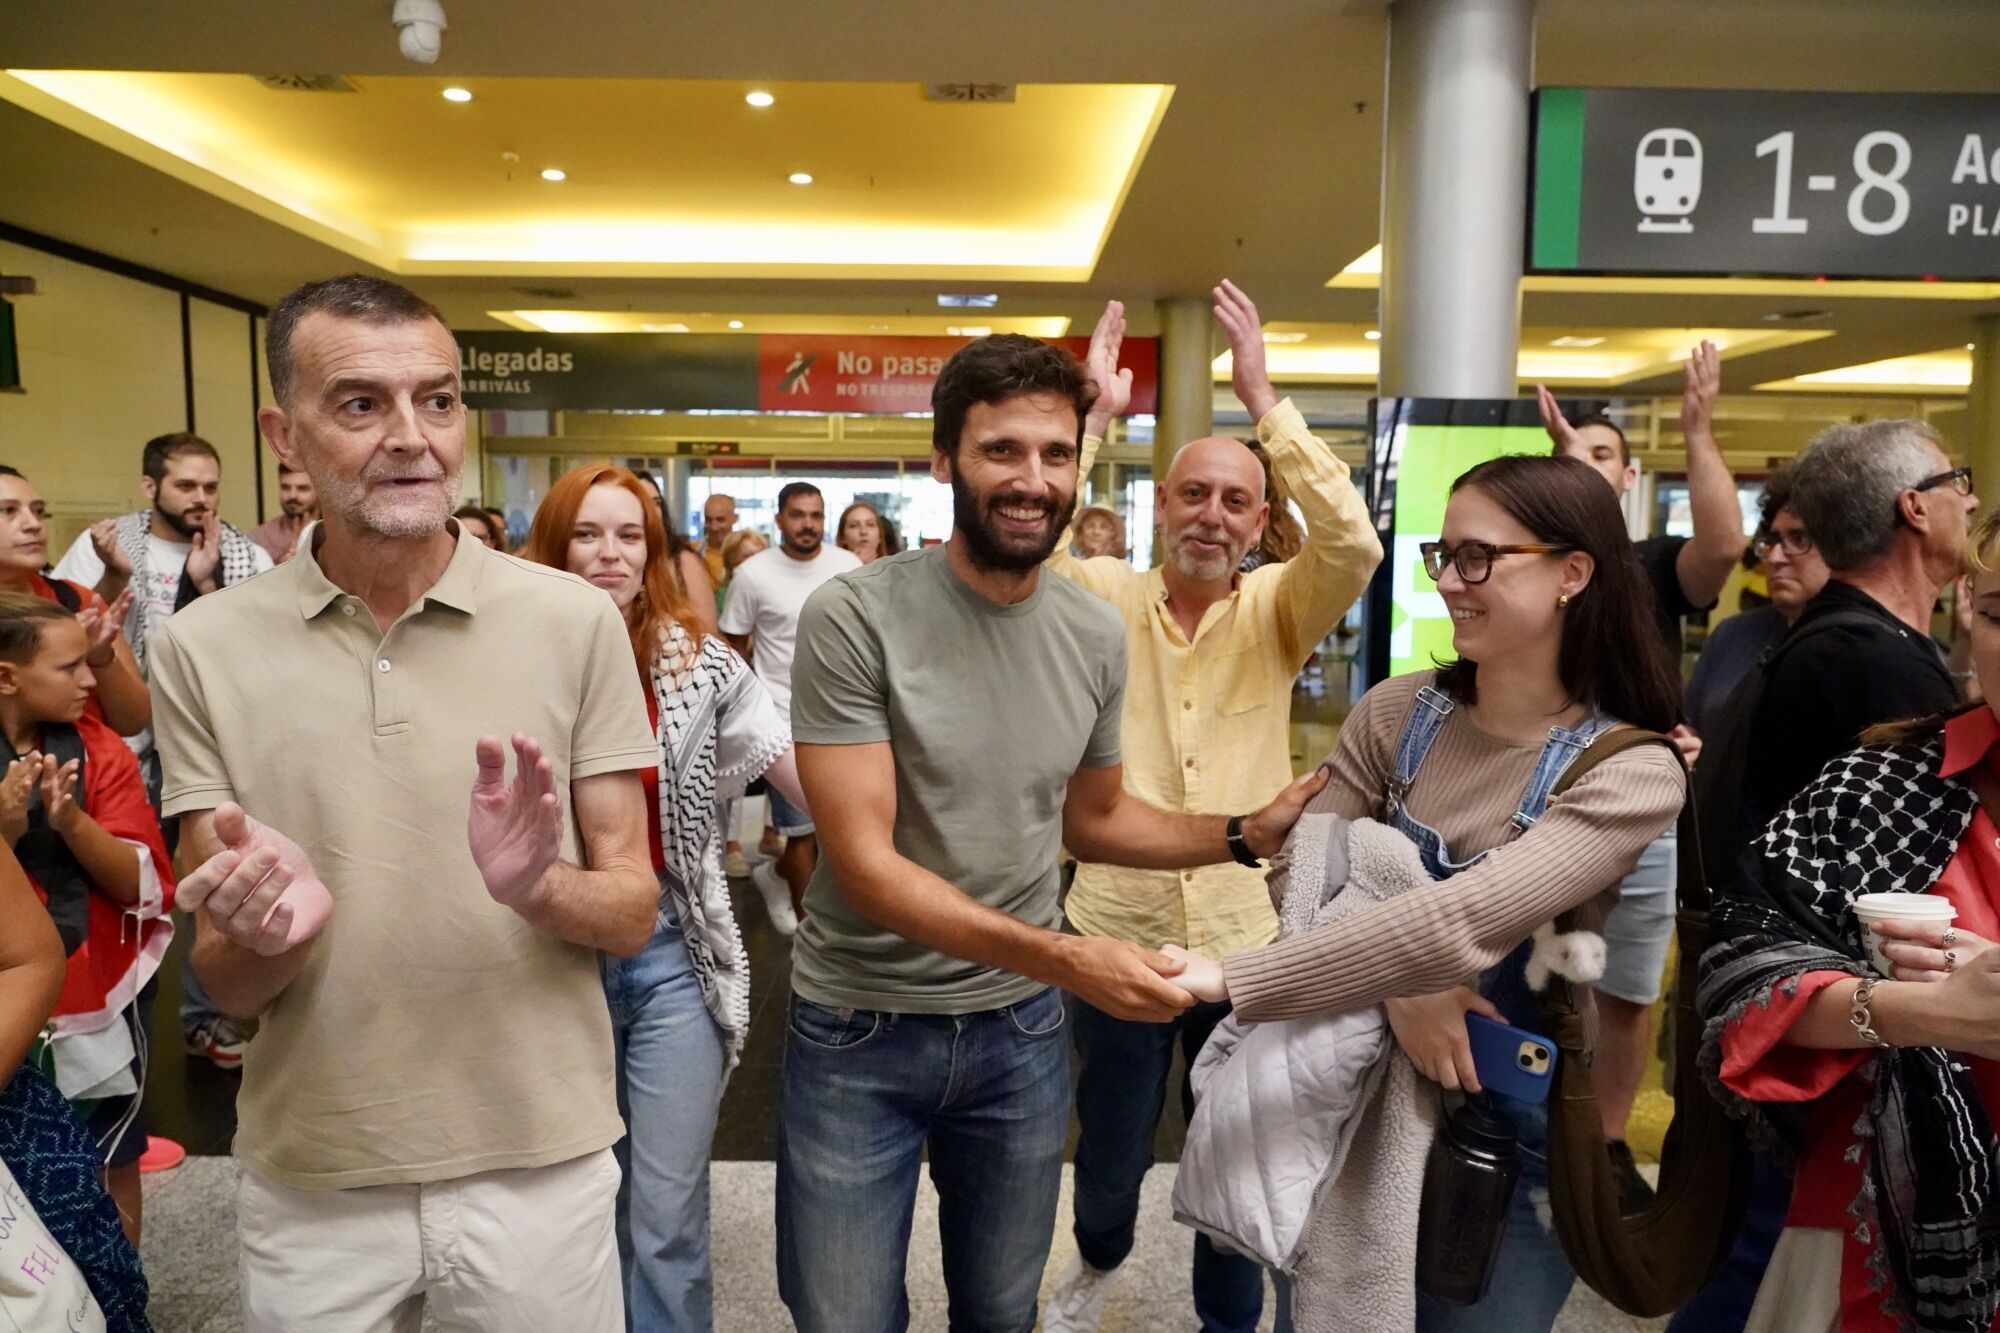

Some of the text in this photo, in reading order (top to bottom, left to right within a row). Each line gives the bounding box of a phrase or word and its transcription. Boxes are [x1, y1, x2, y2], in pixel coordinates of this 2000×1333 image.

[1752, 130, 1912, 236] 1-8
[837, 351, 943, 380] No pasa
[836, 382, 858, 396] NO
